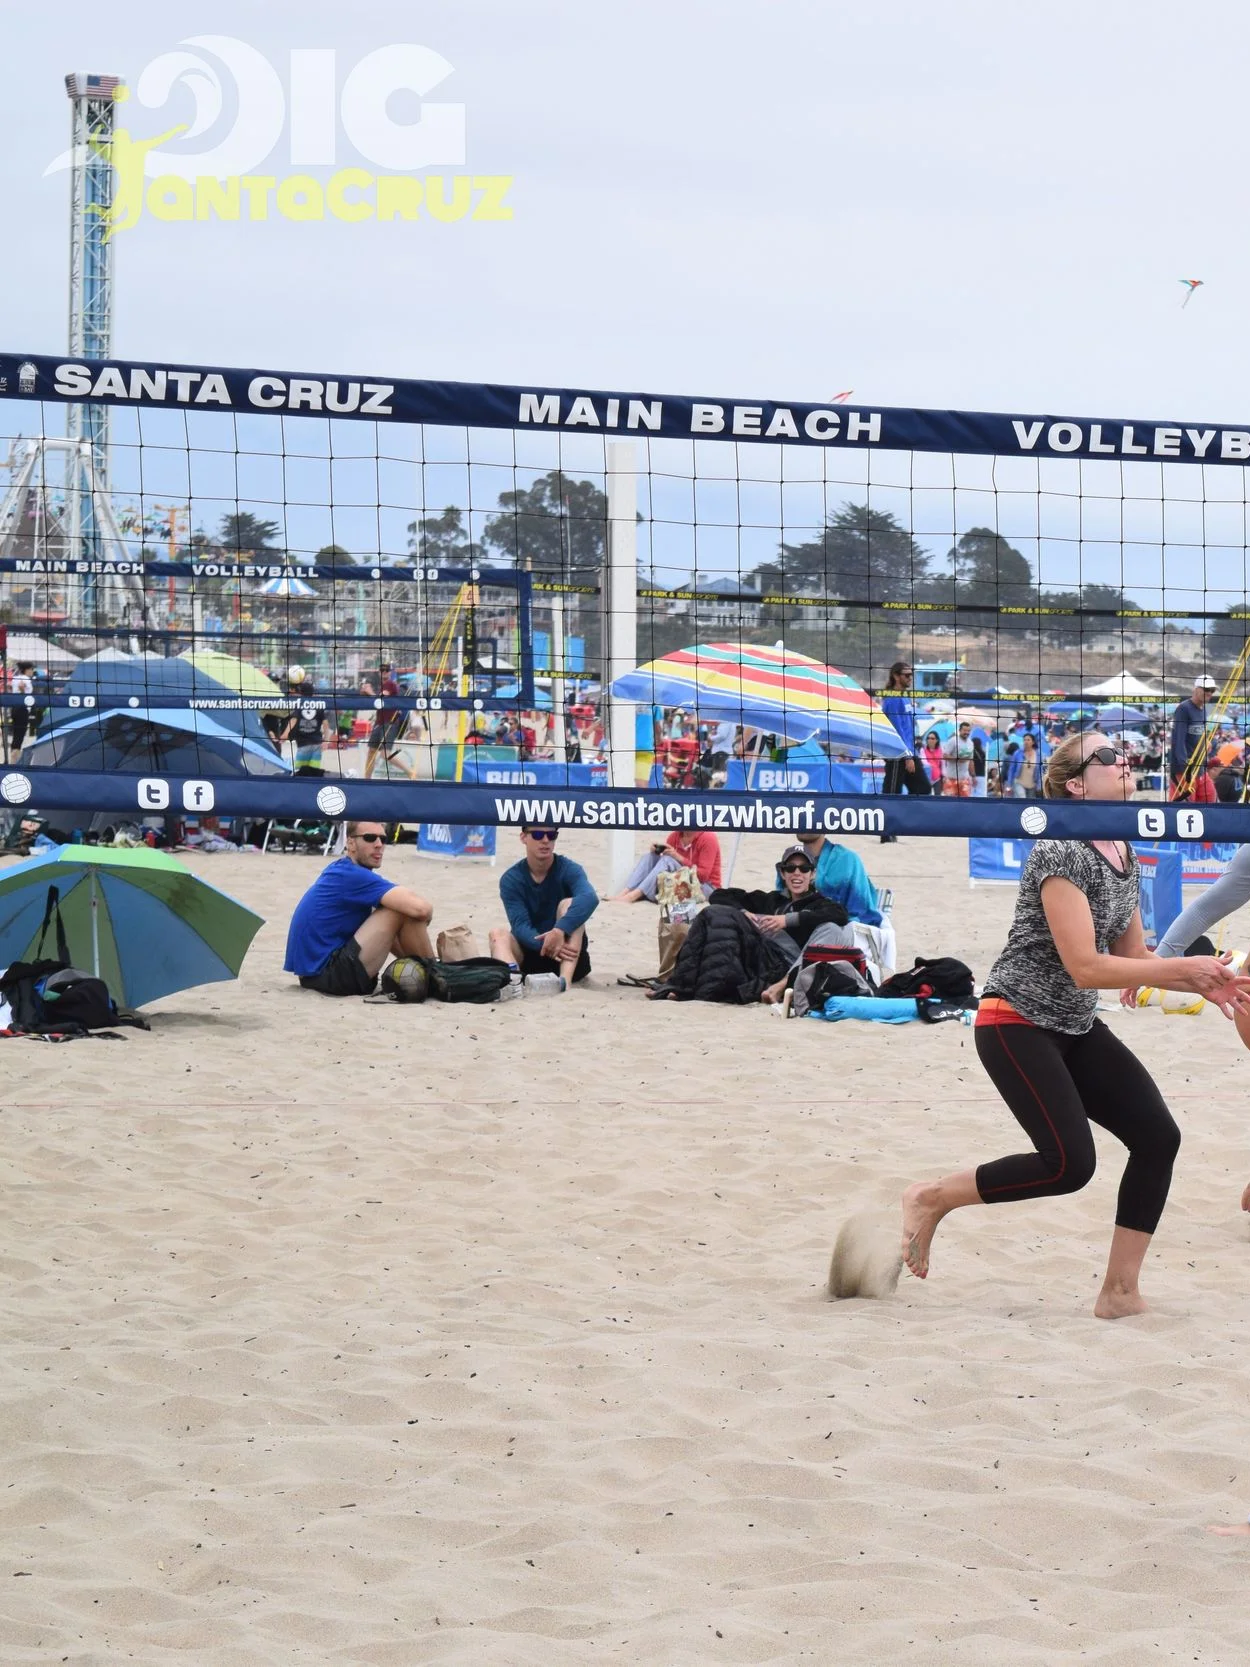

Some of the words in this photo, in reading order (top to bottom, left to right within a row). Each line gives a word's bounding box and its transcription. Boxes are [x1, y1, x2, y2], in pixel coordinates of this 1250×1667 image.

[54, 364, 232, 405] SANTA
[247, 376, 394, 416] CRUZ
[518, 393, 664, 430] MAIN
[690, 403, 882, 442] BEACH
[16, 560, 67, 573] MAIN
[76, 561, 145, 574] BEACH
[192, 564, 319, 578] VOLLEYBALL
[189, 698, 327, 710] www.santacruzwharf.com
[759, 770, 809, 789] BUD
[495, 796, 885, 832] www.santacruzwharf.com
